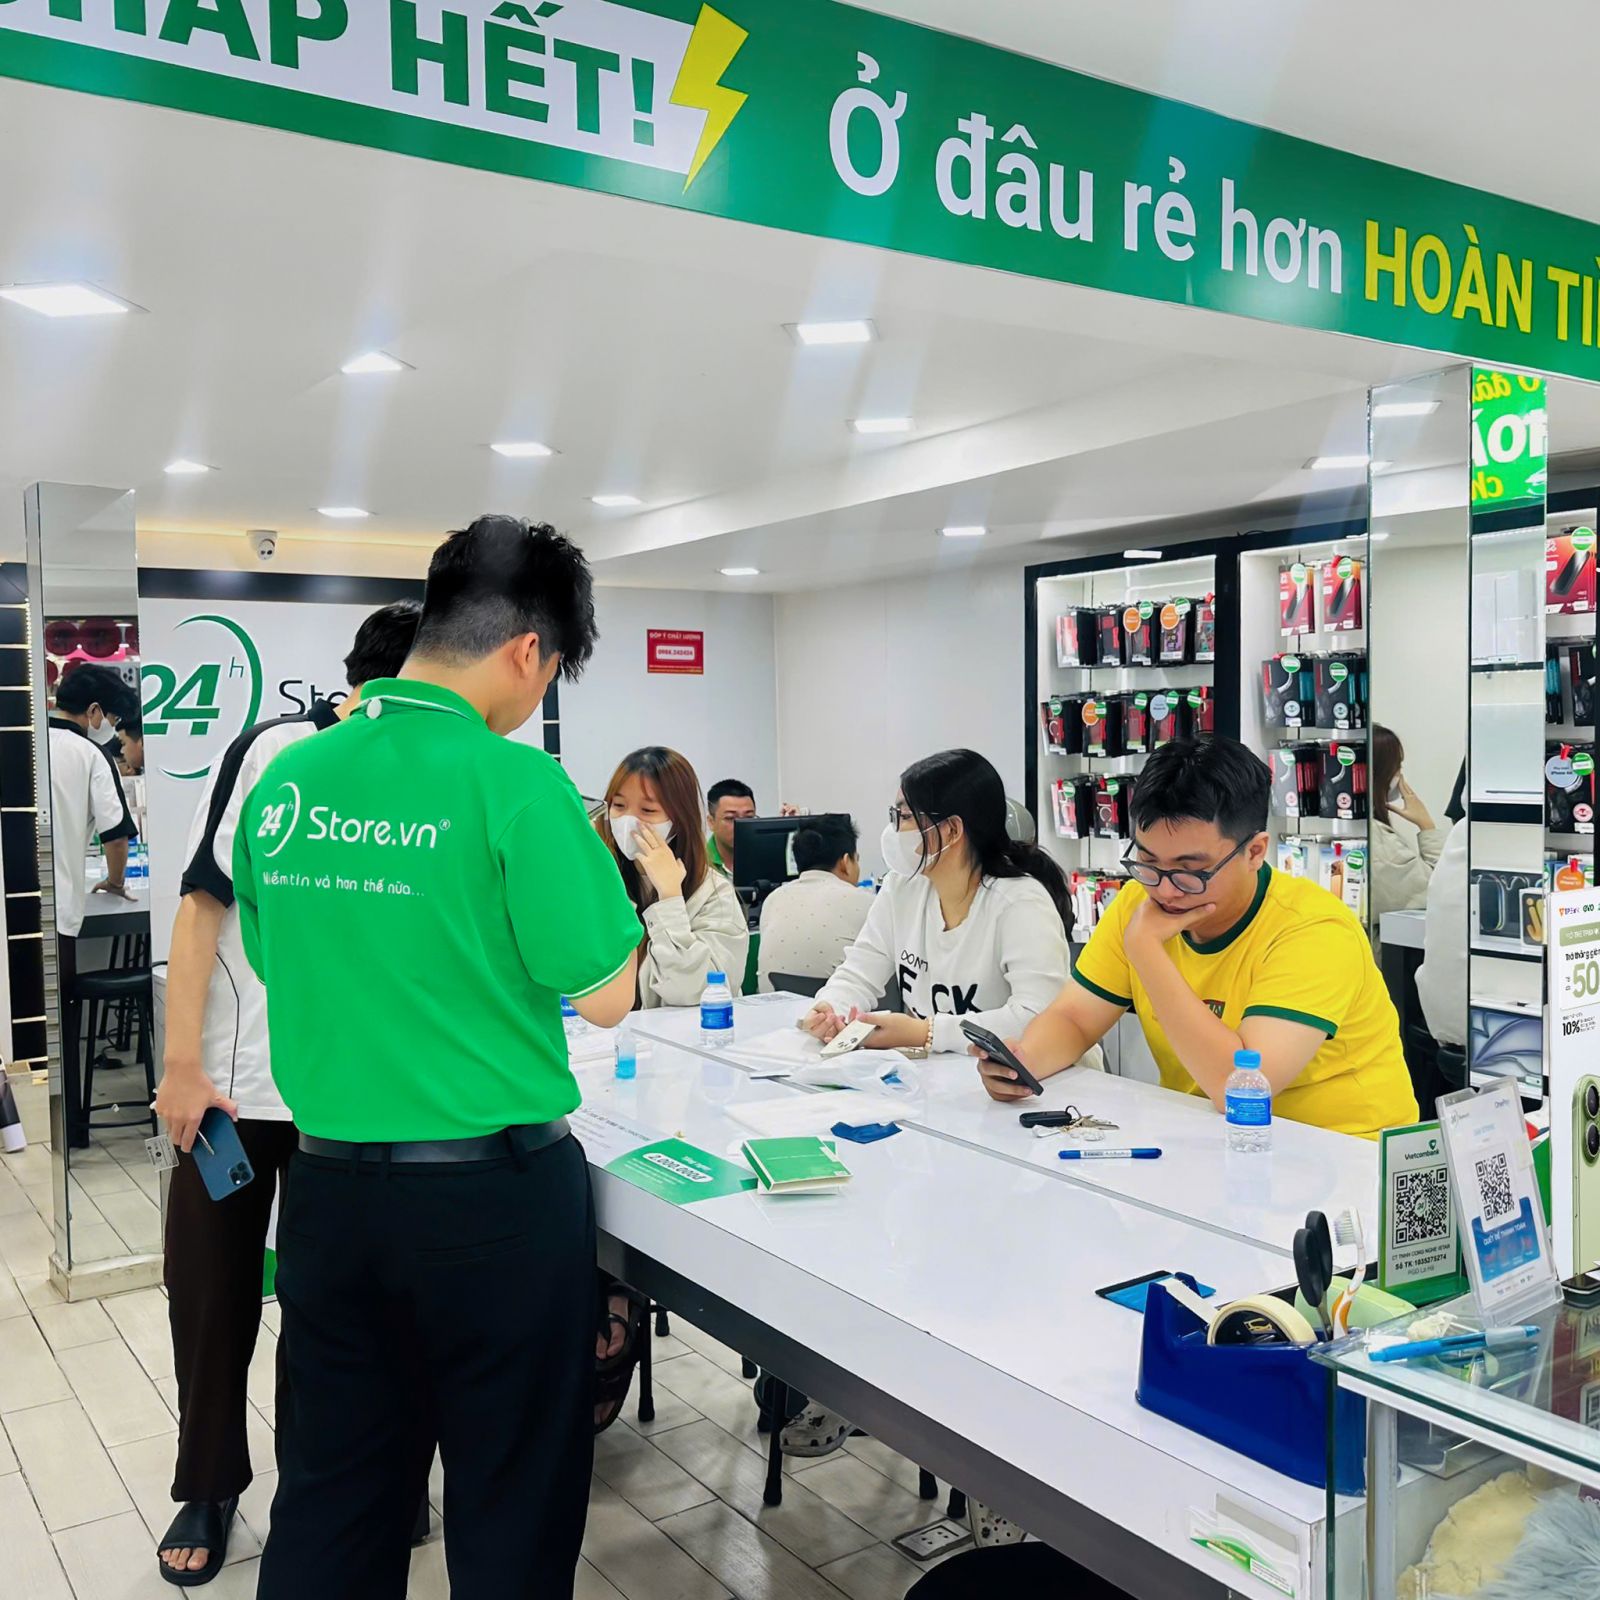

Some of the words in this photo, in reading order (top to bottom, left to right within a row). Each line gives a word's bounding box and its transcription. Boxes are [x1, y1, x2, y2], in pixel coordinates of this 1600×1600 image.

[390, 0, 656, 147] HẾT!
[829, 51, 908, 197] Ở
[935, 112, 1094, 243] đâu
[1123, 155, 1197, 262] rẻ
[1220, 178, 1342, 294] hơn
[1364, 219, 1533, 333] HOÀN
[1546, 256, 1600, 349] TI
[1404, 1148, 1440, 1161] Vietcombank
